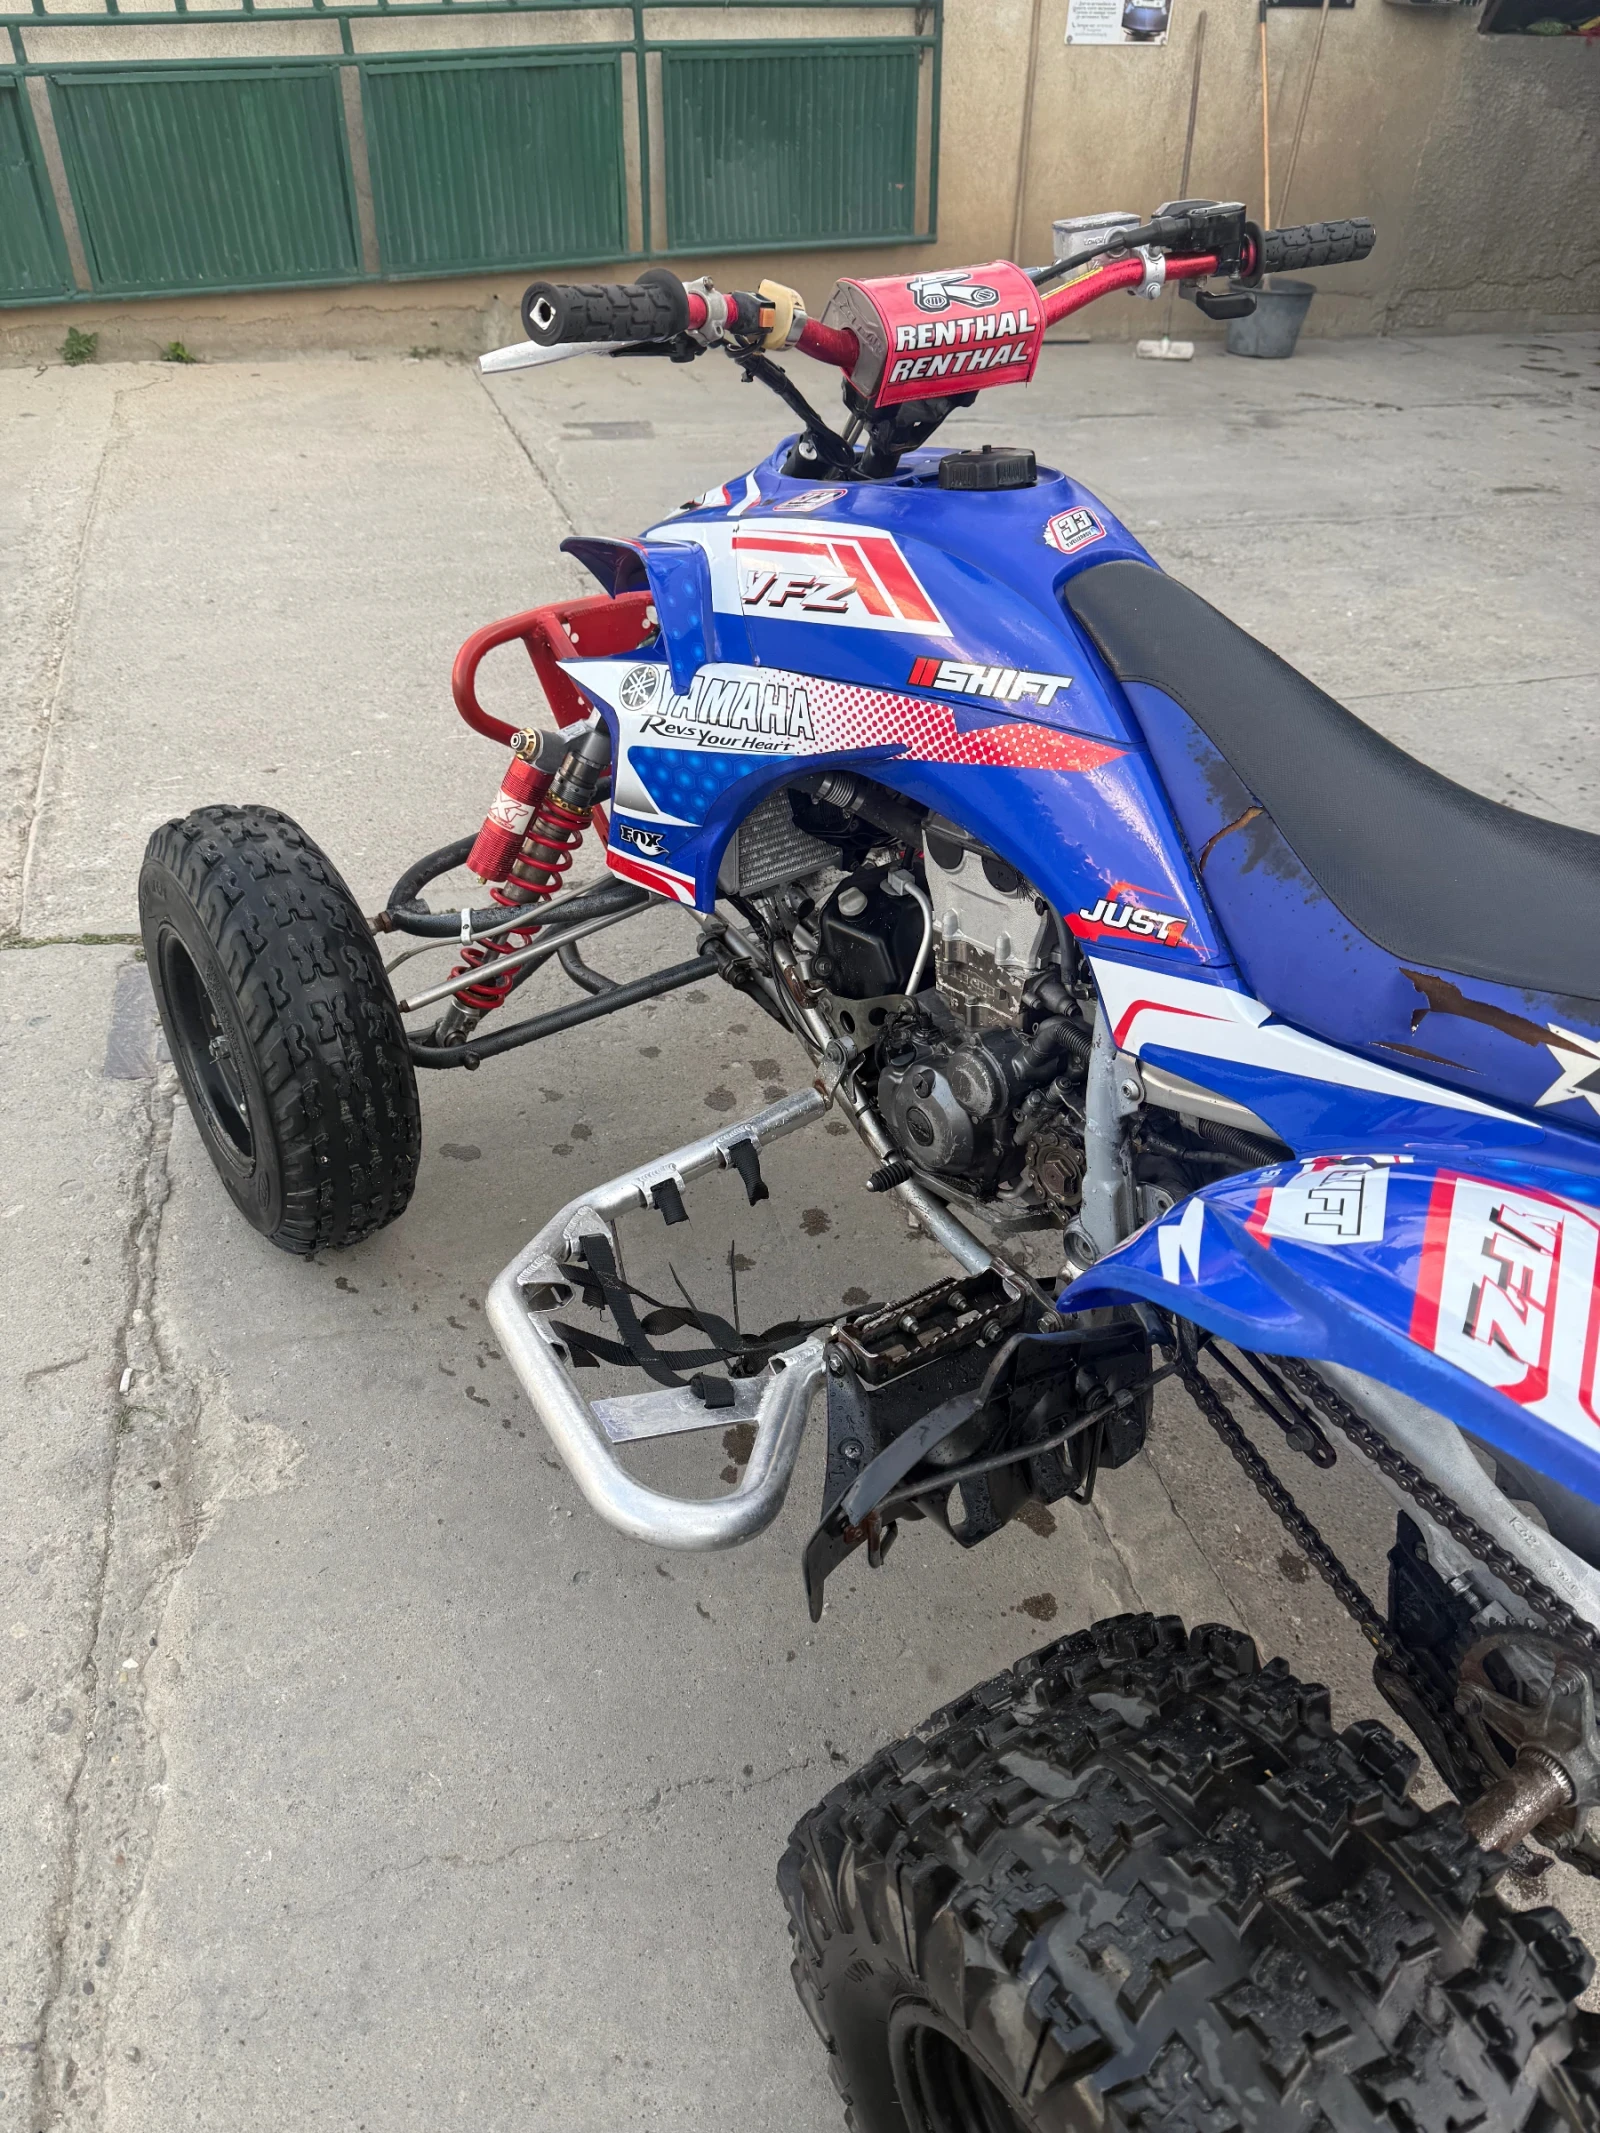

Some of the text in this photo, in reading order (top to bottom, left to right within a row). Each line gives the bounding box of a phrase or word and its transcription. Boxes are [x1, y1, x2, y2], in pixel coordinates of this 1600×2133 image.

[896, 309, 1036, 352] RENTHAL
[889, 341, 1028, 383] RENTHAL
[1057, 509, 1093, 541] 33
[741, 569, 858, 613] YFZ
[931, 659, 1074, 706] SHIFT
[656, 669, 815, 741] YAMAHA
[639, 713, 795, 753] Revs Your Heart
[619, 824, 665, 852] FOX
[1463, 1203, 1562, 1369] YFZ
